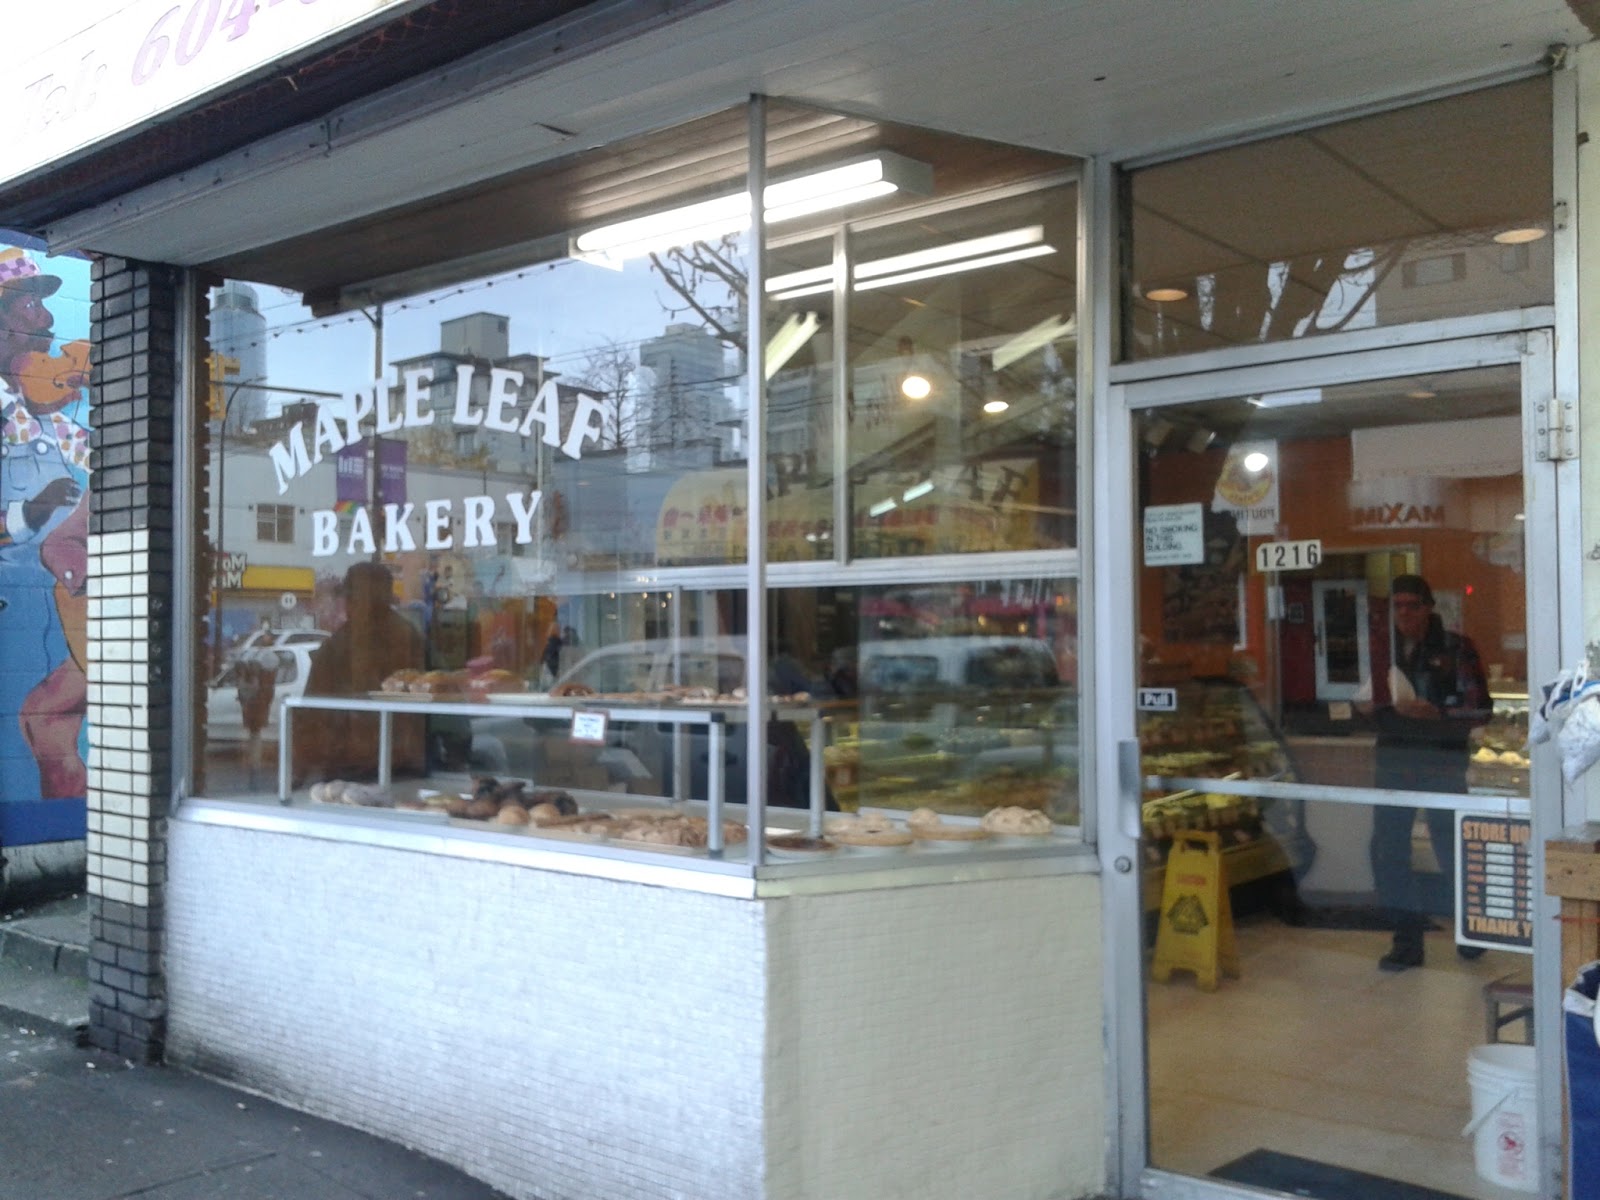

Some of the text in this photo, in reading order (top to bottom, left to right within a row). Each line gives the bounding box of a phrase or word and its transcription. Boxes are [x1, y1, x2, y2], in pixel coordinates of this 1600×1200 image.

[268, 364, 610, 496] MAPLE LEAF
[312, 490, 543, 557] BAKERY
[1261, 543, 1319, 568] 1216
[1462, 820, 1509, 843] STORE
[1467, 915, 1520, 938] THANK
